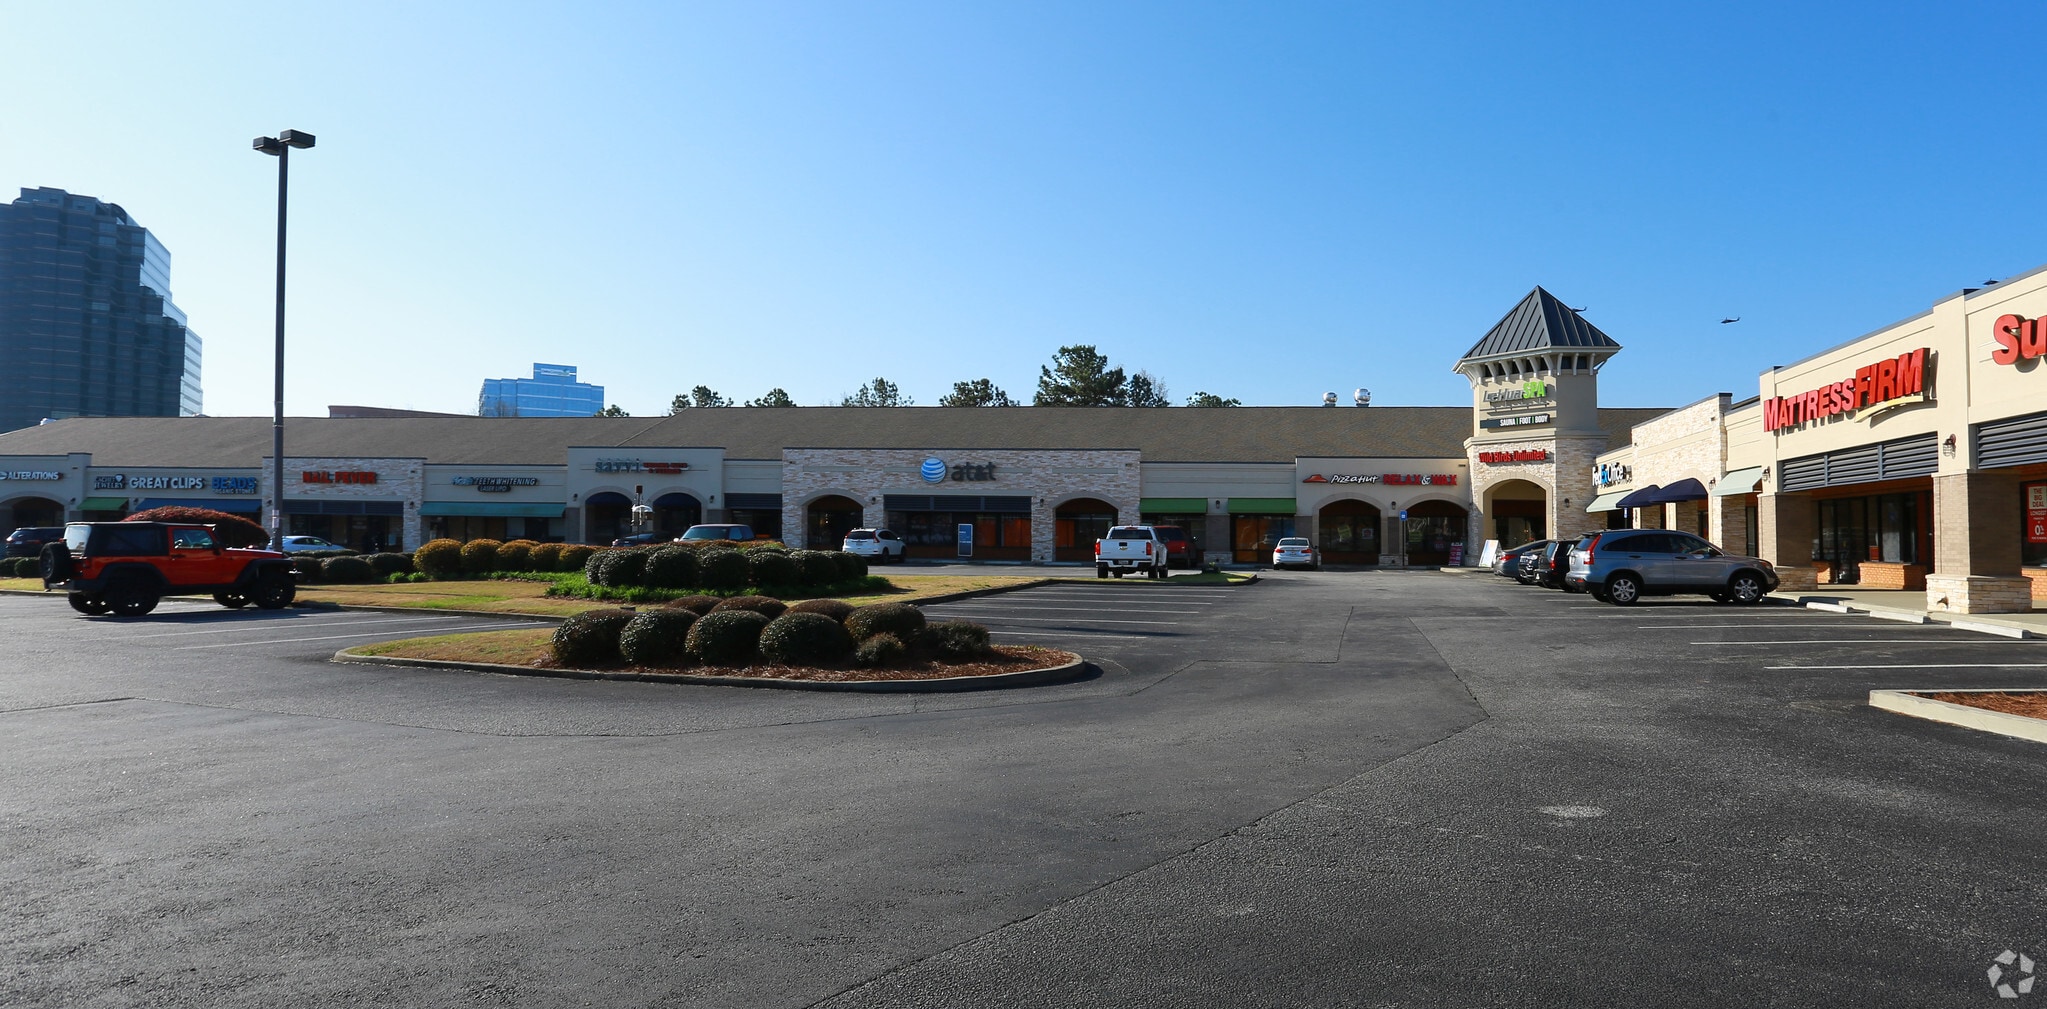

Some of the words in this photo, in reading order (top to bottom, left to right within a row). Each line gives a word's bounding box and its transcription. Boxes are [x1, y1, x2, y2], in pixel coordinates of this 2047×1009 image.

[1500, 418, 1515, 427] SAUNA
[1519, 417, 1532, 426] FOOT
[1535, 415, 1549, 424] BODY
[1493, 451, 1511, 462] Birds
[1513, 448, 1546, 461] Unlimited
[7, 471, 60, 480] ALTERATIONS
[951, 461, 996, 481] at&t
[129, 477, 169, 489] GREAT
[171, 477, 204, 489] CLIPS
[212, 476, 257, 489] BEADS
[496, 477, 536, 486] WHITENING
[1383, 474, 1421, 485] RELAX
[1421, 475, 1431, 485] &
[1431, 474, 1457, 486] WAX
